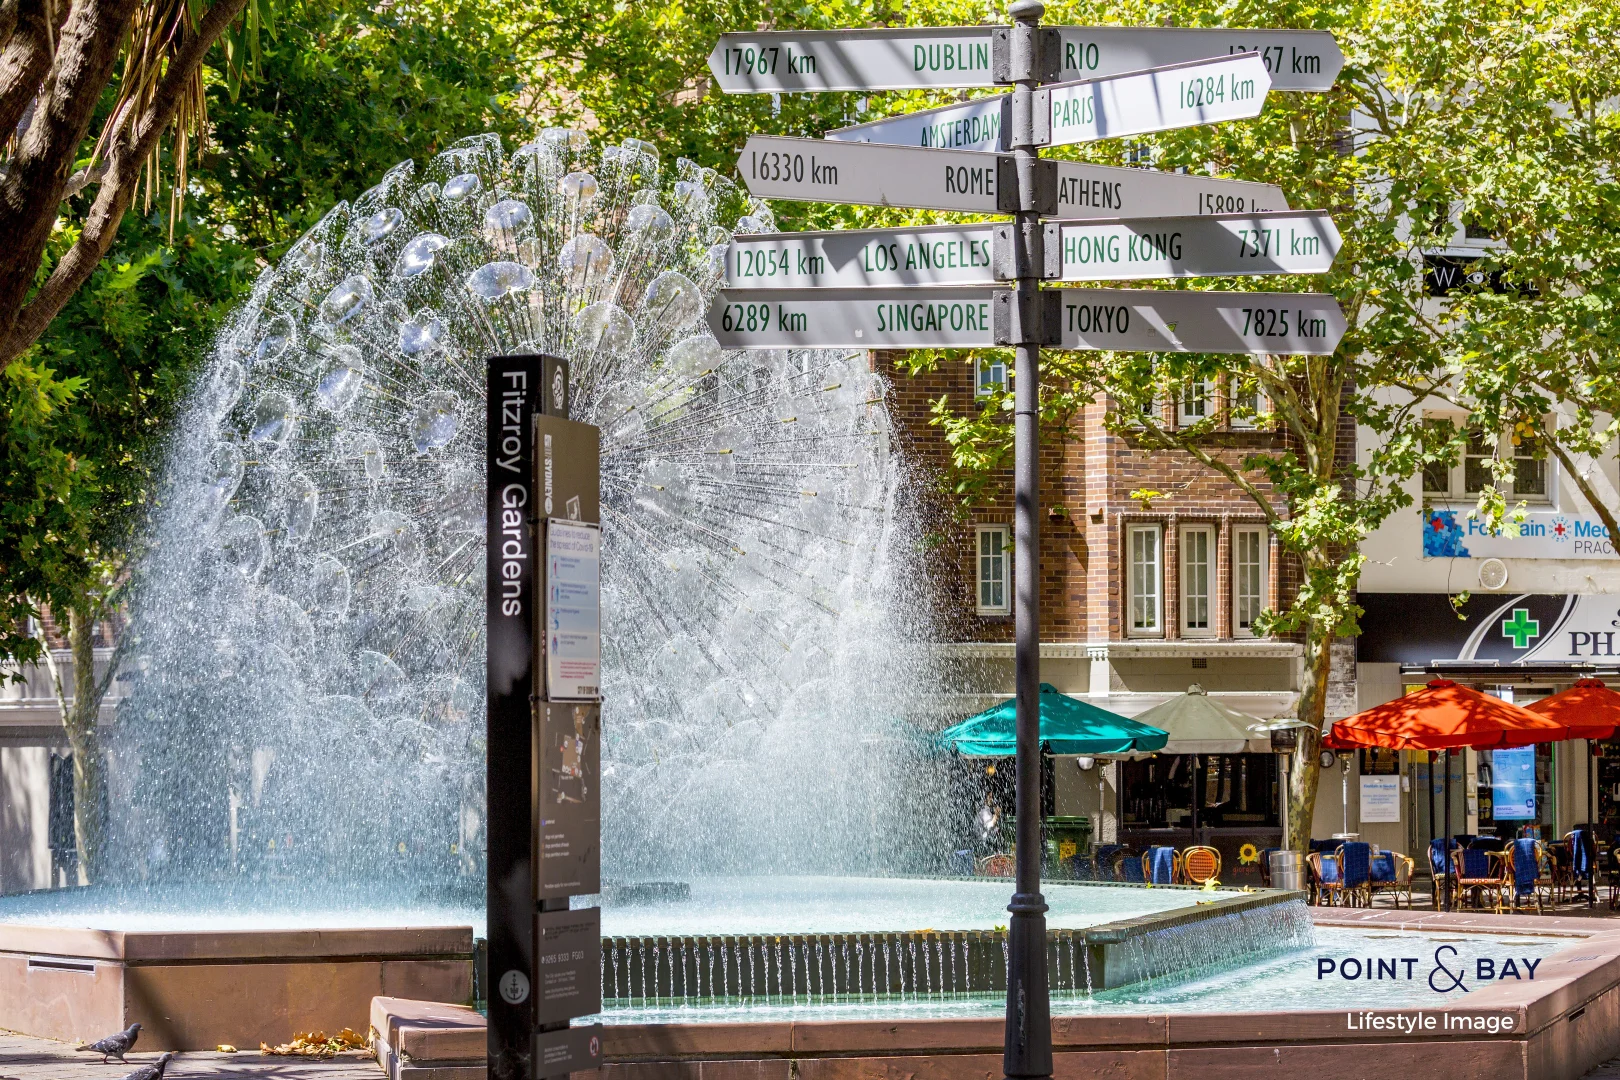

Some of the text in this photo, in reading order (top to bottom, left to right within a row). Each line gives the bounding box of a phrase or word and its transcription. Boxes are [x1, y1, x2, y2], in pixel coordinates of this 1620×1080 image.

[725, 43, 989, 76] 17967 km DUBLIN
[1065, 42, 1100, 71] RIO
[1292, 46, 1321, 74] km
[1053, 73, 1255, 129] PARIS 16284 km
[920, 111, 1001, 149] AMSTERDAM
[752, 151, 995, 196] 16330 km ROME
[1058, 176, 1122, 210] ATHENS
[736, 238, 990, 278] 12054 km LOS ANGELES
[1064, 227, 1320, 265] HONG KONG 7371 km
[722, 303, 989, 333] 6289 km SINGAPORE
[1066, 304, 1327, 338] TOKYO 7825 km
[496, 371, 528, 616] Fitzroy Gardens
[1568, 631, 1620, 656] PH
